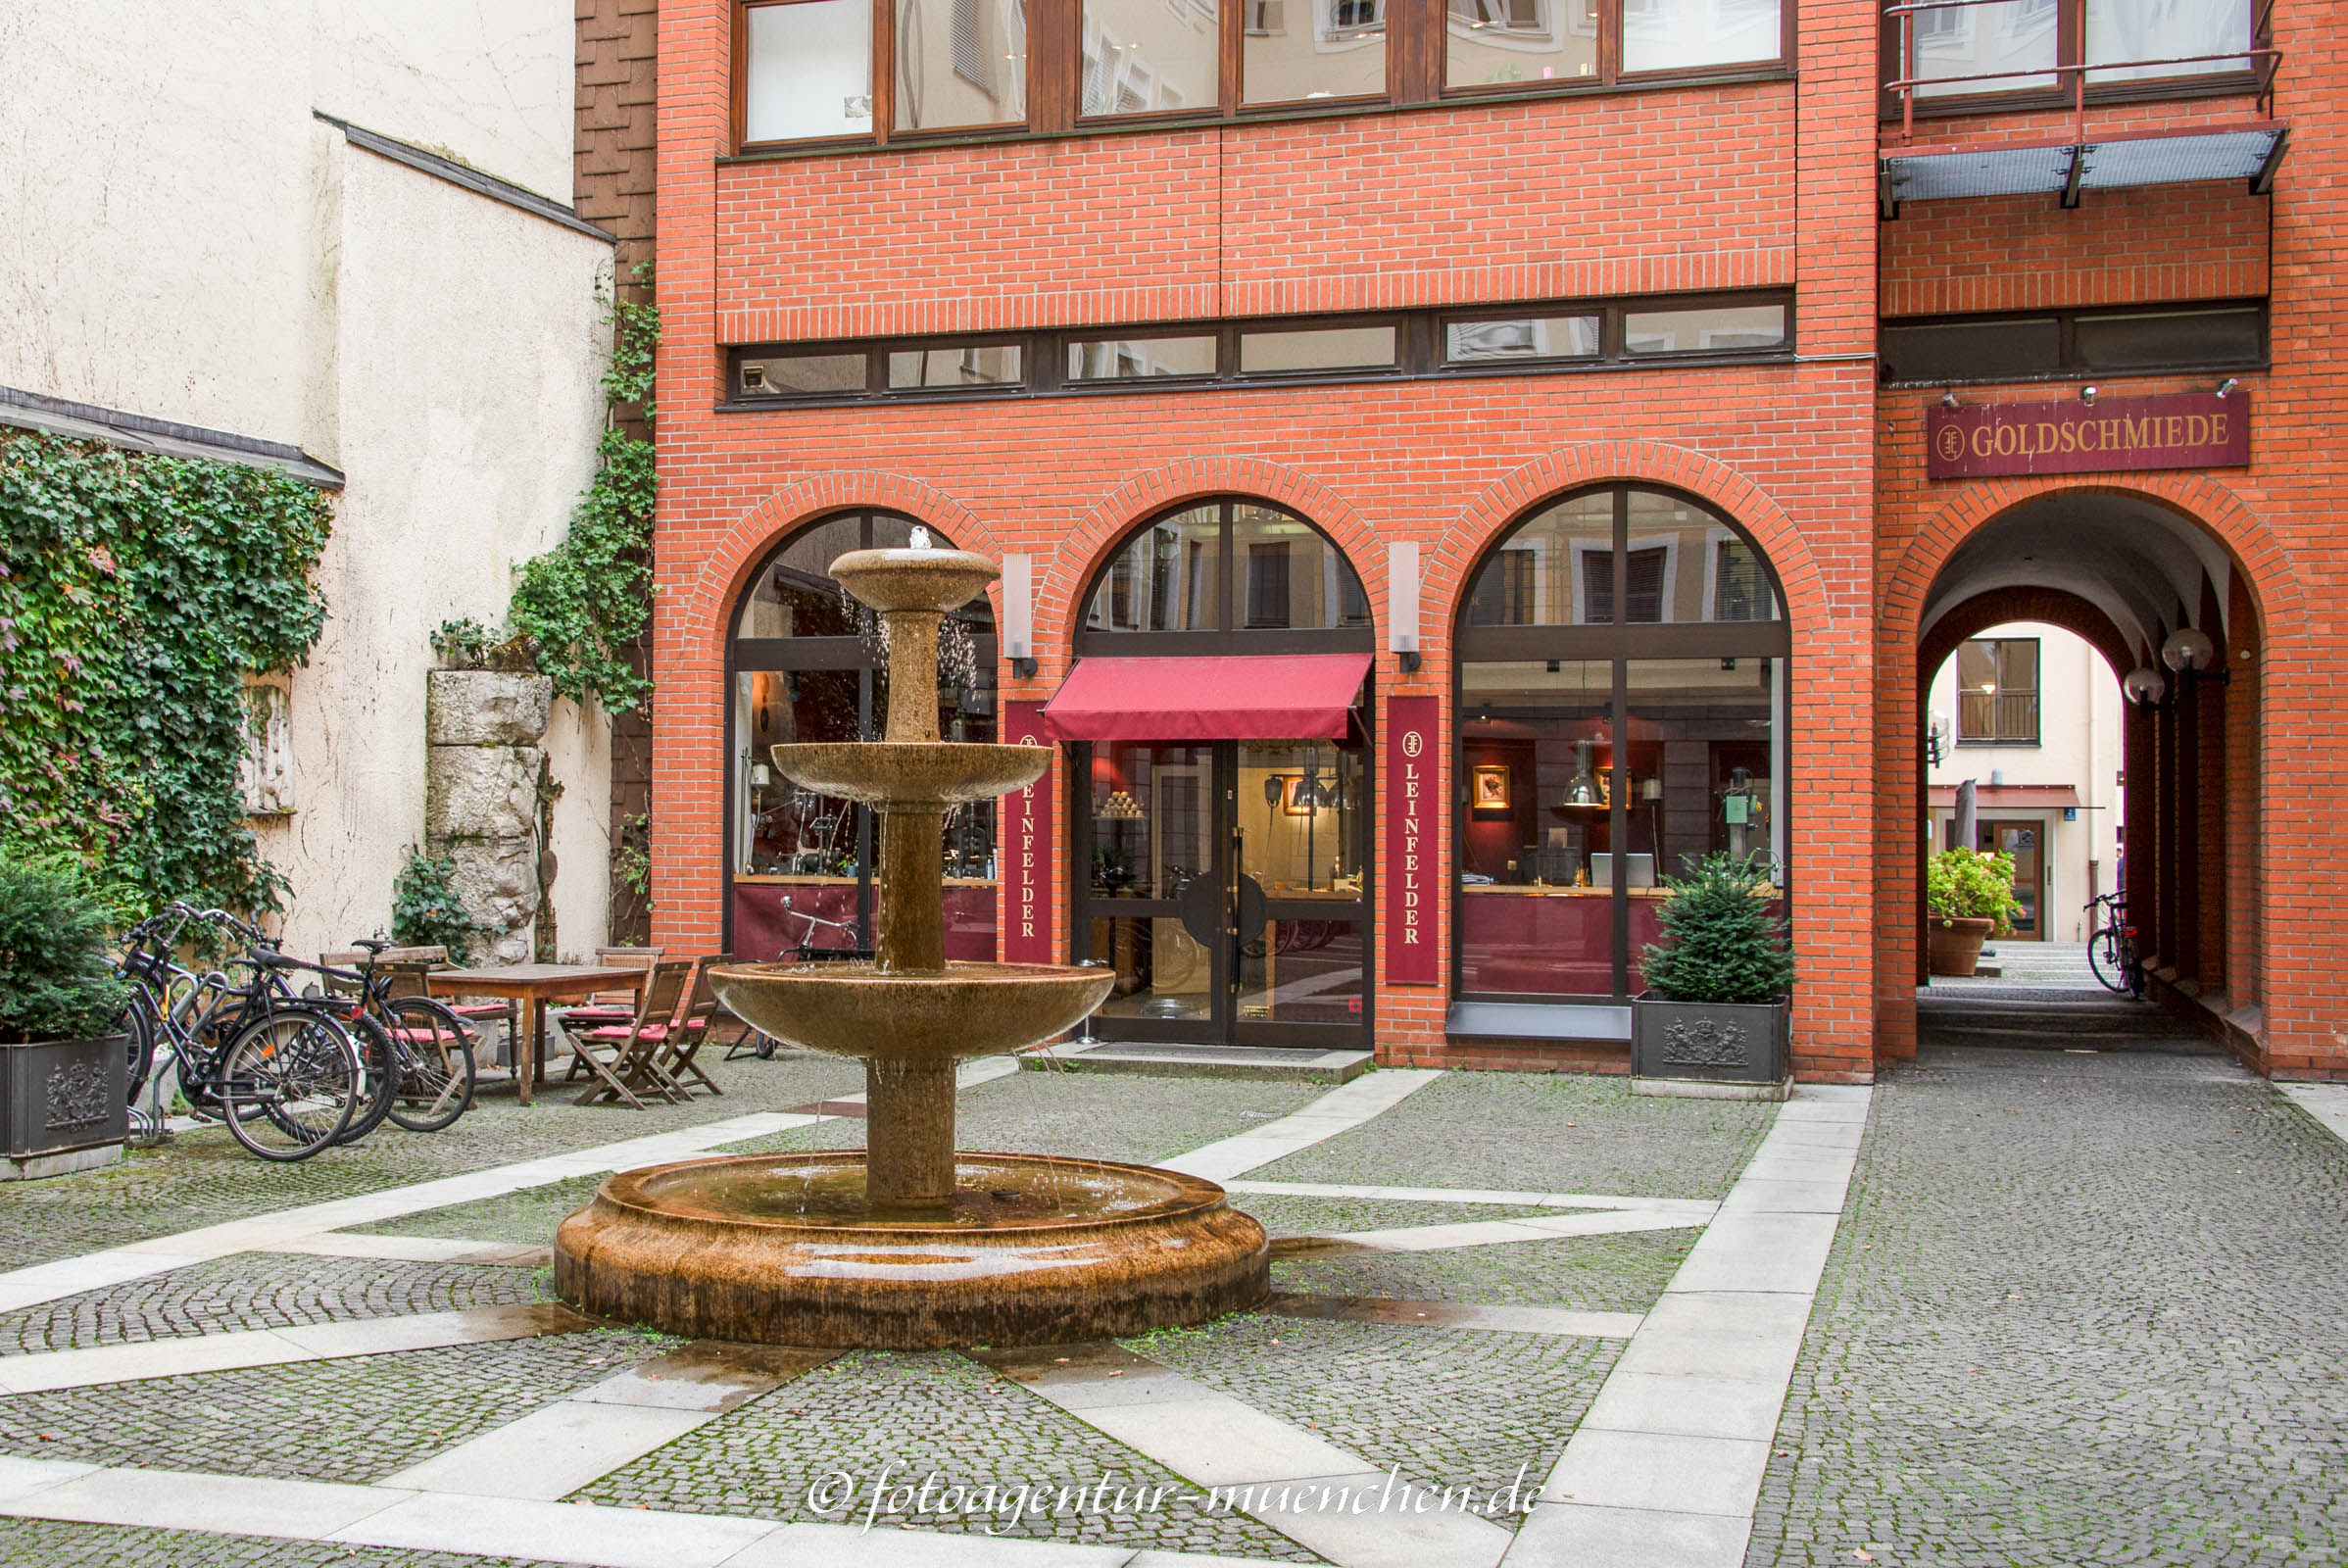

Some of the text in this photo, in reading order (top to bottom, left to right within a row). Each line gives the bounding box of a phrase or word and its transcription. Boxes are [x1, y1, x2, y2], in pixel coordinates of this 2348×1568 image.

[1972, 414, 2230, 457] GOLDSCHMIEDE
[1021, 783, 1035, 937] EINFELDER
[1404, 763, 1419, 944] LEINFELDER
